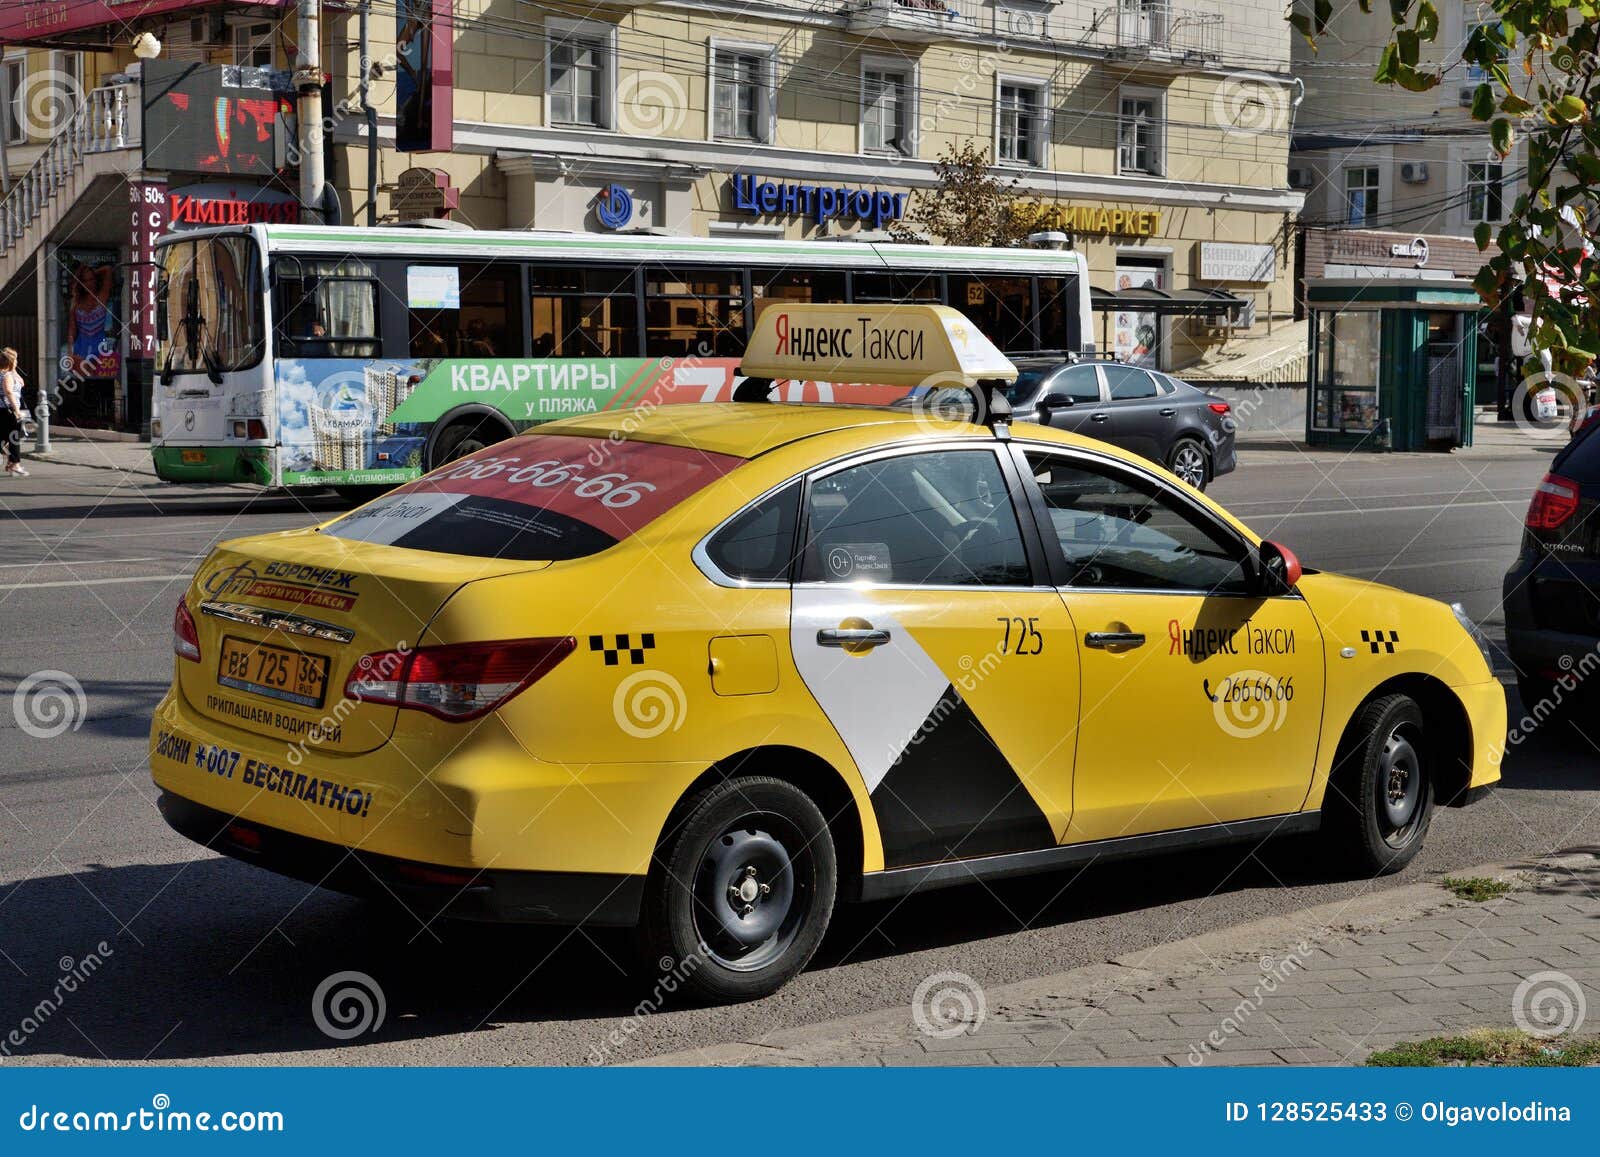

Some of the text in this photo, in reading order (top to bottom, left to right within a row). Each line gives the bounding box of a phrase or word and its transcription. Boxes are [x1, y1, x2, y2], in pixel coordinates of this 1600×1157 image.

[144, 186, 165, 204] 50%
[169, 193, 299, 224] ИМПЕРИЯ
[732, 173, 908, 229] Центрторг
[969, 287, 984, 300] 52
[774, 313, 925, 362] Яндекс Такси
[450, 362, 617, 392] КВАРТИРЫ
[539, 397, 598, 413] ПЛЯЖА
[264, 561, 360, 589] ВОРОНЕЖ
[254, 585, 347, 609] ФОРМУЛА ТАКСИ
[996, 616, 1043, 656] 725
[1168, 618, 1295, 660] Яндекс Такси
[256, 649, 290, 686] 725
[298, 656, 318, 684] 36
[1223, 676, 1294, 702] 266 66 66
[206, 695, 342, 744] ПРИГЛАШАЕМ ВОДИТЕЛЕЙ
[156, 730, 191, 765] ЗВОНИ
[243, 759, 372, 818] БЕСПЛАТНО!
